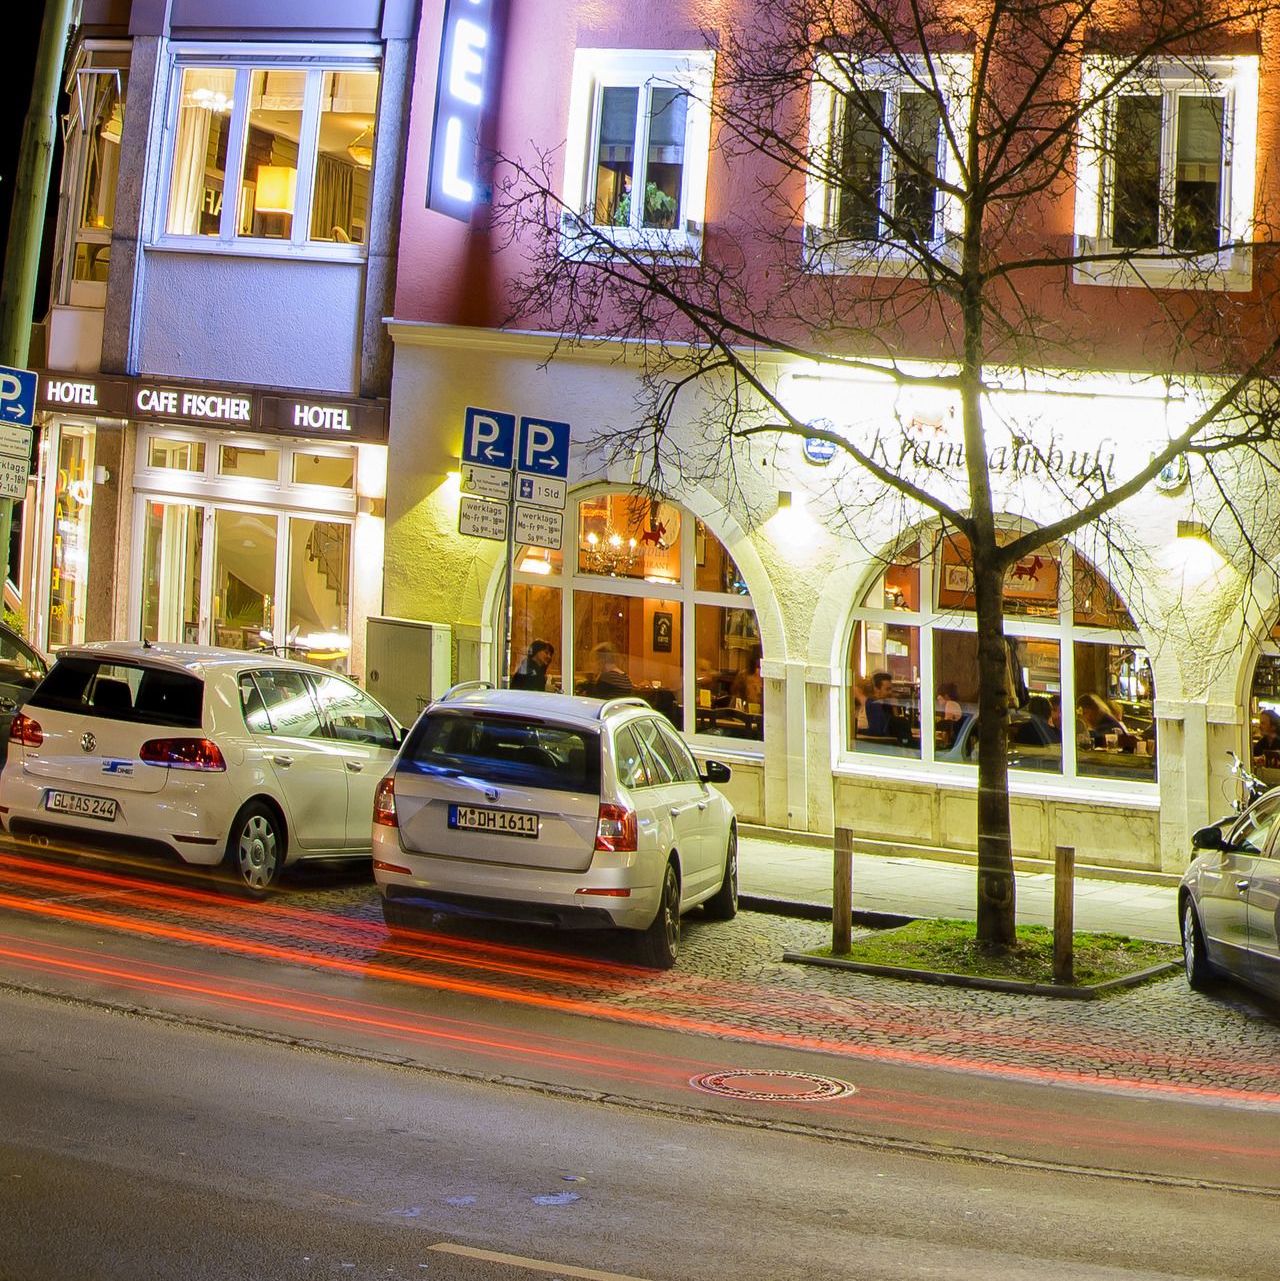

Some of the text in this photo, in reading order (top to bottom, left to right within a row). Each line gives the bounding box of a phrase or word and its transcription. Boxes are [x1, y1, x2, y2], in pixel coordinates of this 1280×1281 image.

[47, 381, 98, 405] HOTEL
[137, 389, 250, 420] CAFE FISCHER
[293, 404, 351, 431] HOTEL
[471, 414, 500, 457] P
[526, 424, 555, 466] P
[522, 512, 558, 525] werktags
[53, 793, 114, 817] GL AS 244
[458, 809, 535, 832] M DH 1611
